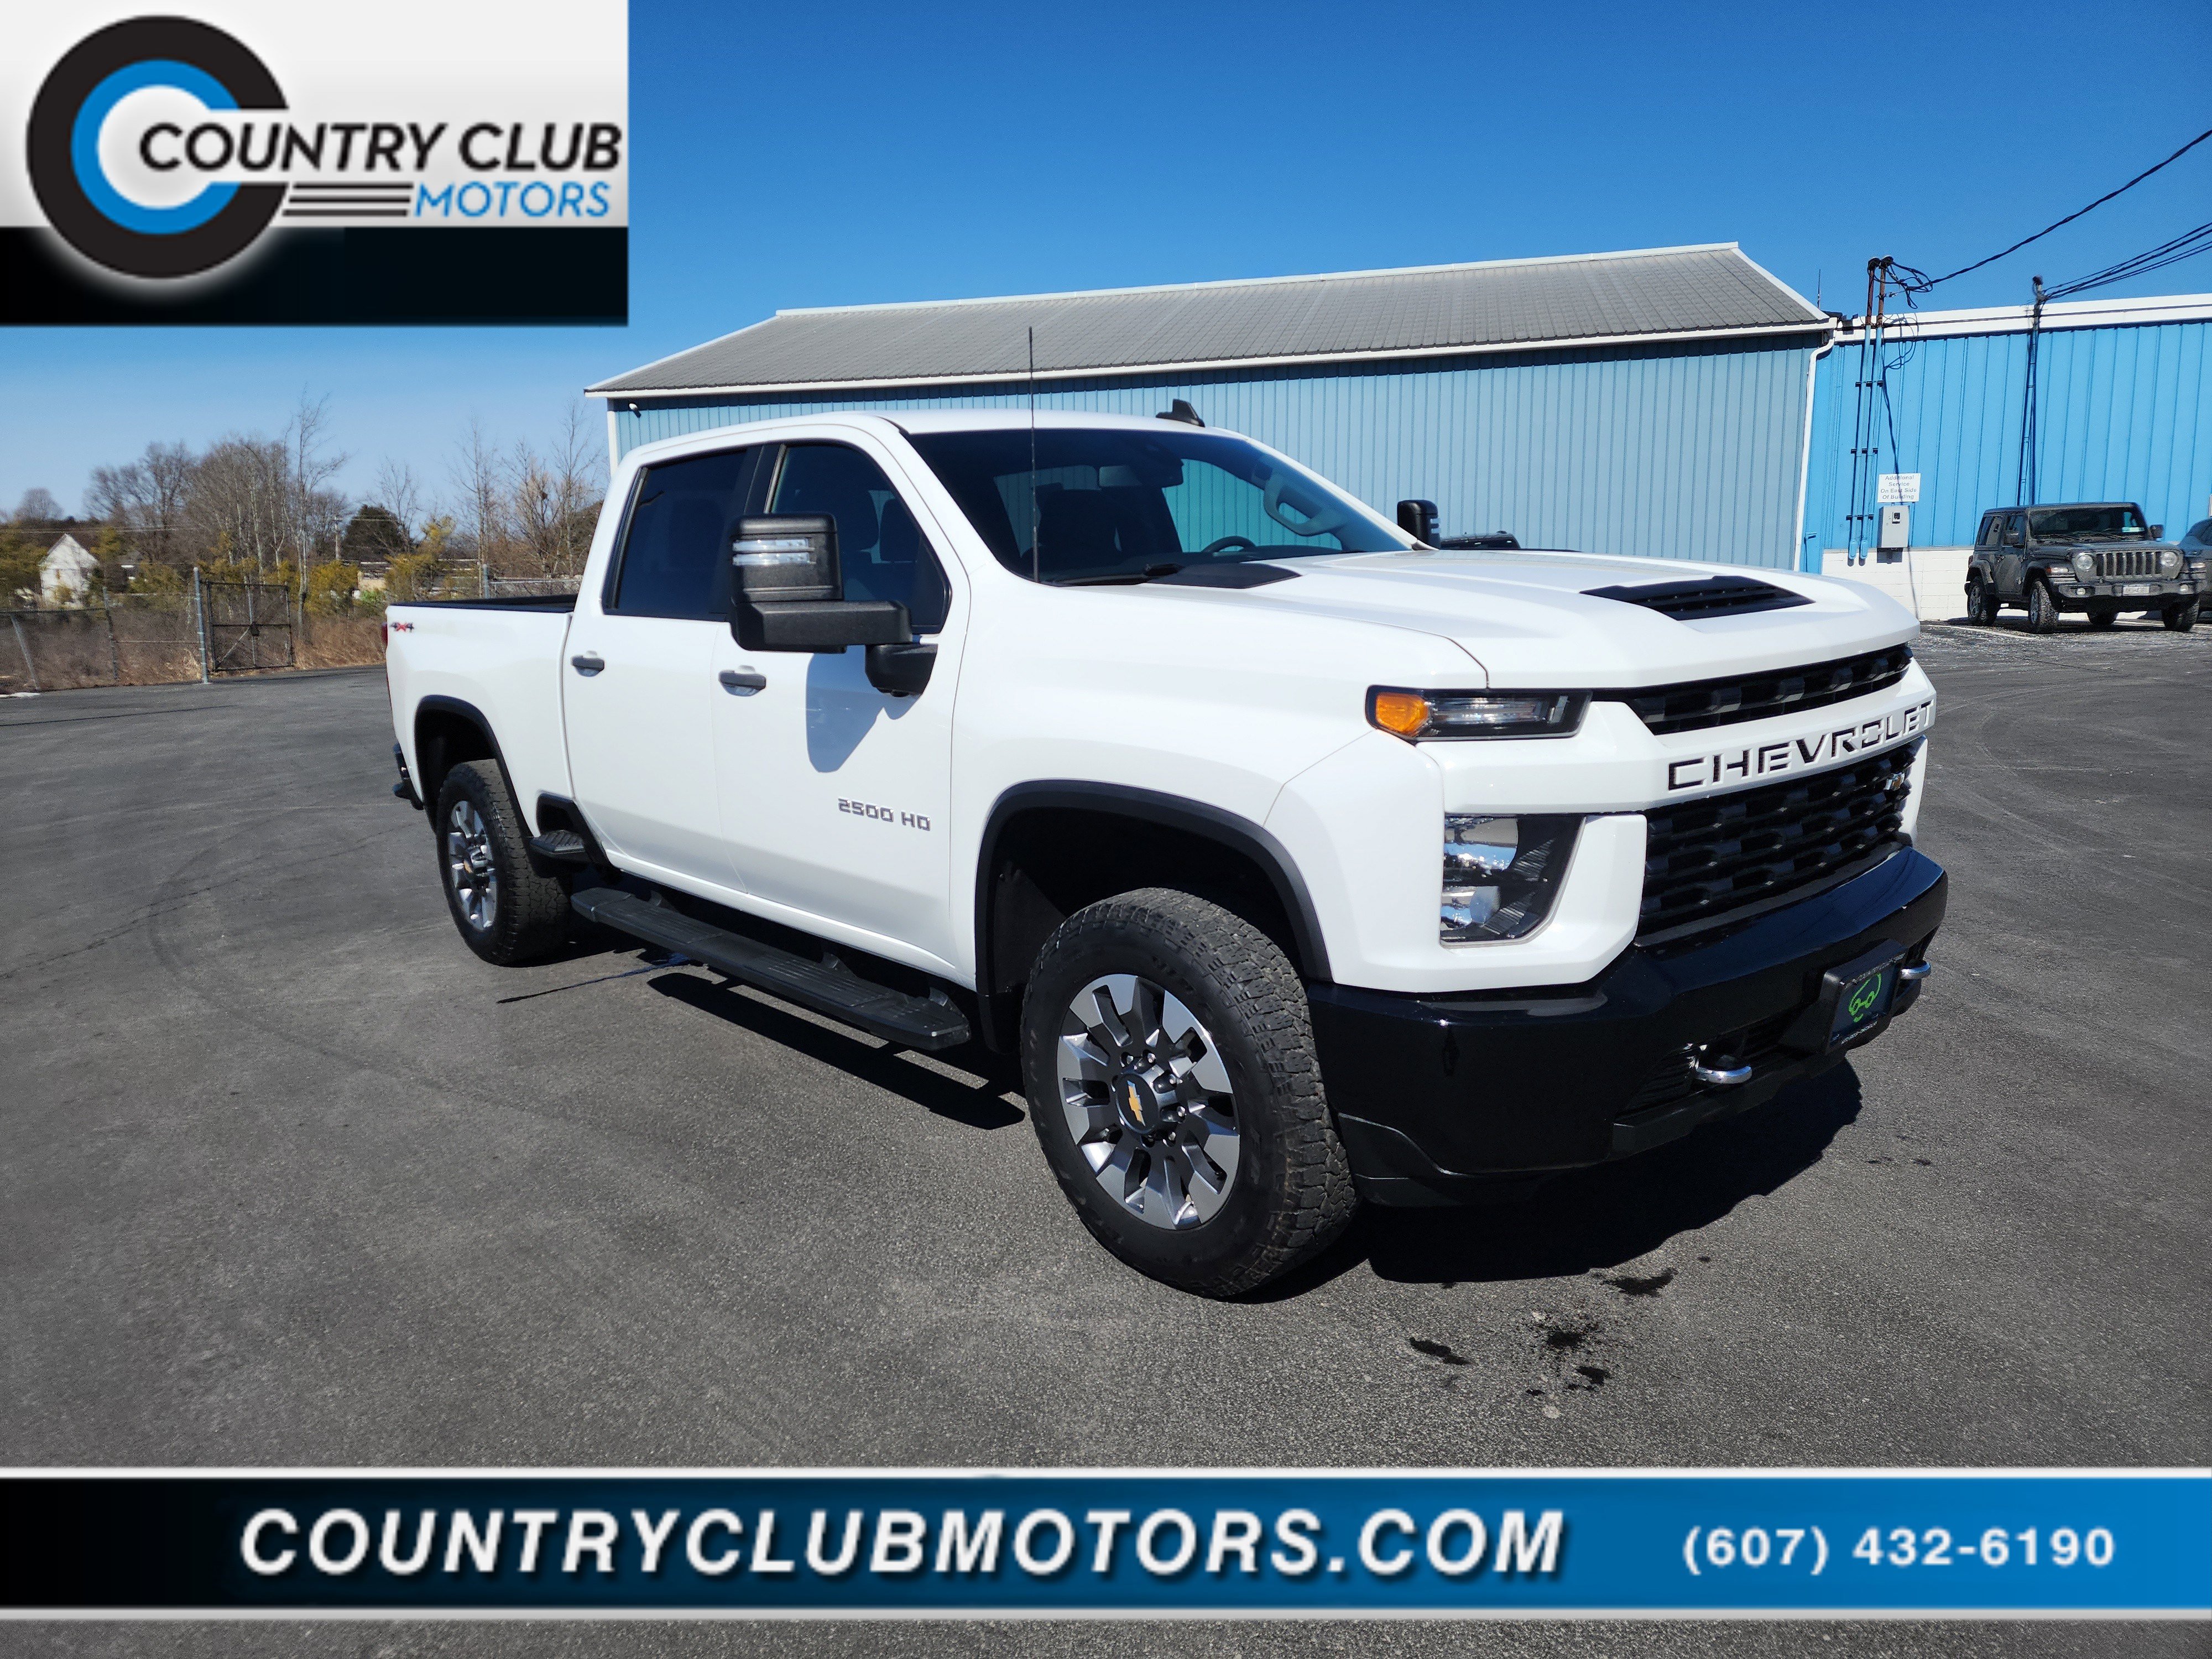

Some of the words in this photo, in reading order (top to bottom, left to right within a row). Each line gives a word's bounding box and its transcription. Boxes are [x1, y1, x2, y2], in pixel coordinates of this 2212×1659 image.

[1668, 698, 1935, 791] CHEVROLET
[838, 796, 894, 823] 2500
[900, 810, 931, 832] HD
